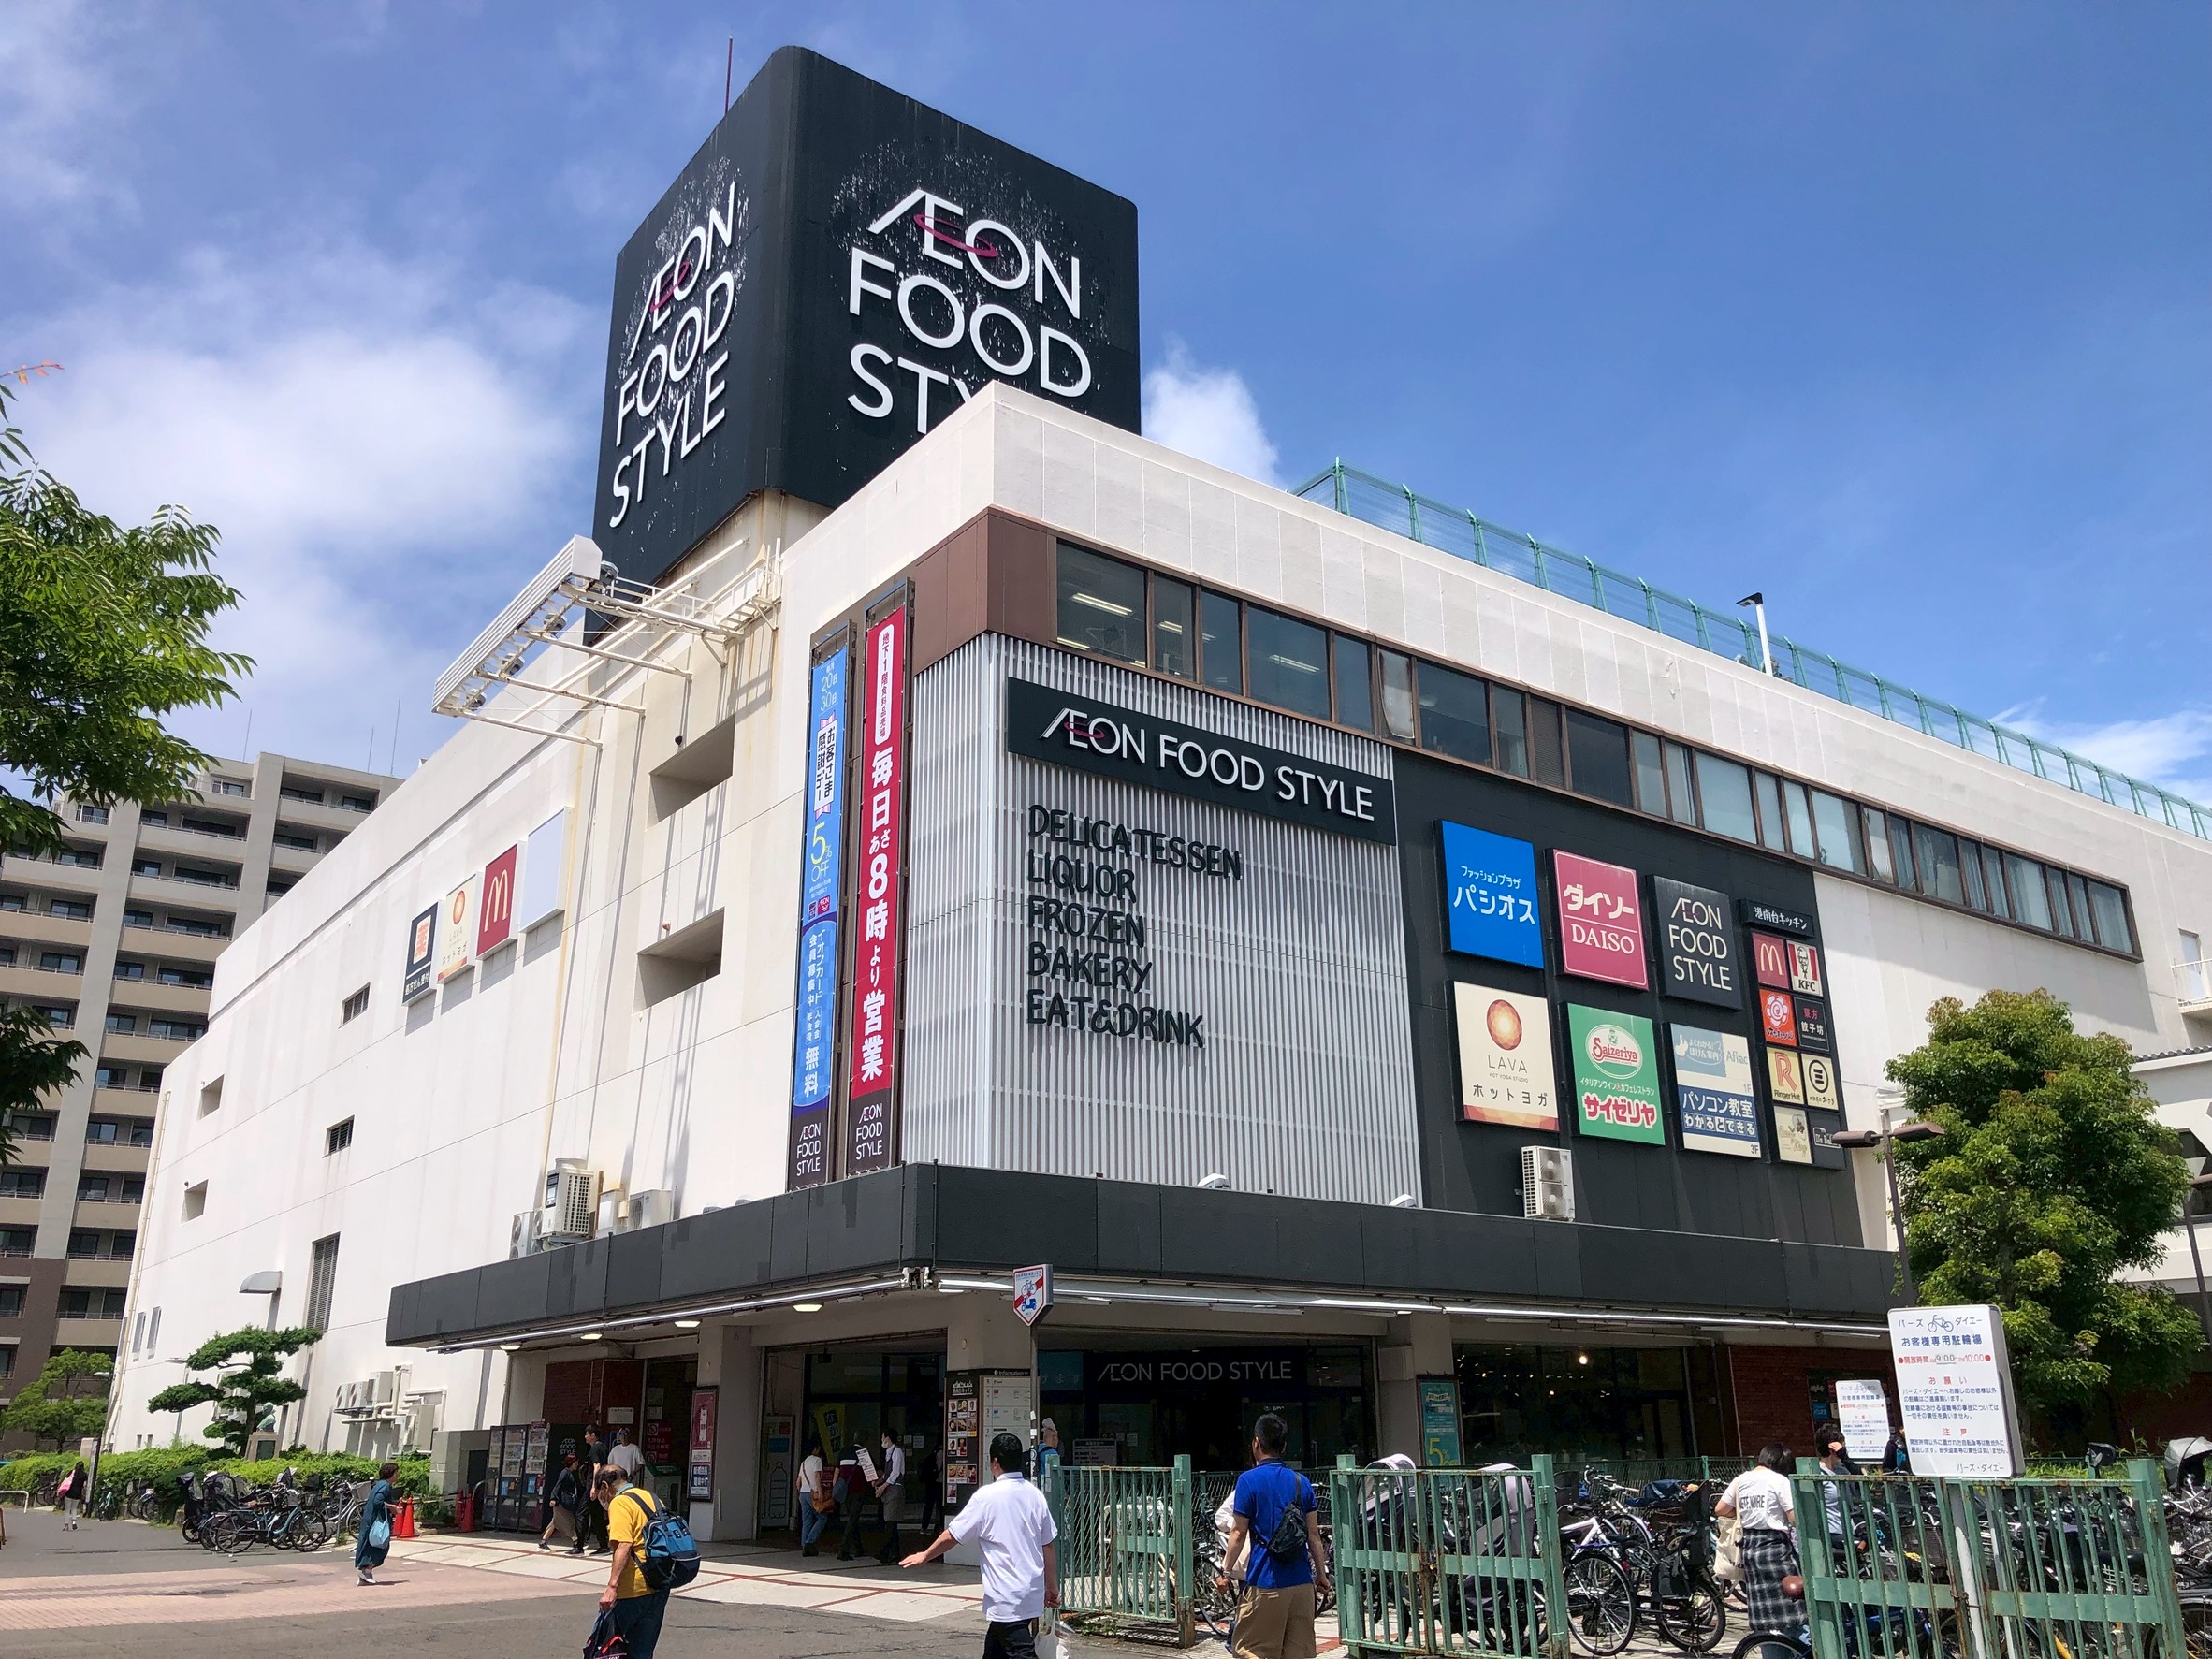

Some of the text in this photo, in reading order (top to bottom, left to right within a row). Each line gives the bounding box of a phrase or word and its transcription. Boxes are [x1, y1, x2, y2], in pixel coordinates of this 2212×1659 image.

[849, 246, 1092, 398] FOOD
[616, 270, 734, 447] FOOD
[609, 350, 730, 529] STYLE
[1158, 734, 1265, 790] FOOD
[1276, 766, 1375, 822] STYLE
[1028, 804, 1243, 881] DELICATESSEN
[811, 859, 830, 882] OFF
[1027, 849, 1137, 903] LIQUOR
[1461, 865, 1522, 890] ファッションプラザ
[1453, 883, 1536, 924] パシオス
[1564, 882, 1635, 920] ダイソー
[1027, 895, 1144, 948] FROZEN
[1754, 906, 1808, 930] 港南台キッチン
[1570, 923, 1635, 955] DAISO
[1668, 924, 1727, 960] FOOD
[807, 934, 817, 1007] 会員募集中
[813, 929, 825, 1005] イオンカード
[1027, 940, 1153, 995] BAKERY
[1673, 956, 1732, 991] STYLE
[1797, 980, 1816, 993] KFC
[1026, 989, 1204, 1048] EAT&DRINK
[1803, 1008, 1818, 1020] 東方
[1800, 1021, 1824, 1036] 餃子坊
[1591, 1036, 1638, 1062] Saizeriya
[1689, 1047, 1719, 1062] ほけん案内
[804, 1046, 820, 1098] 無料
[1488, 1055, 1528, 1074] LAVA
[1472, 1084, 1549, 1107] ホットヨガ
[1742, 1084, 1752, 1093] 1F
[1583, 1093, 1657, 1129] サイゼリヤ
[1682, 1091, 1754, 1119] パソコン教室
[855, 1121, 883, 1142] FOOD
[1683, 1113, 1755, 1136] わかるとできる
[796, 1140, 821, 1159] FOOD
[855, 1140, 883, 1160] STYLE
[1750, 1143, 1759, 1155] 3F
[796, 1157, 821, 1176] STYLE
[1955, 1316, 1983, 1327] ダイエー
[1901, 1334, 1983, 1347] お客様専用駐輪場
[1160, 1362, 1222, 1381] FOOD
[1230, 1361, 1292, 1380] STYLE
